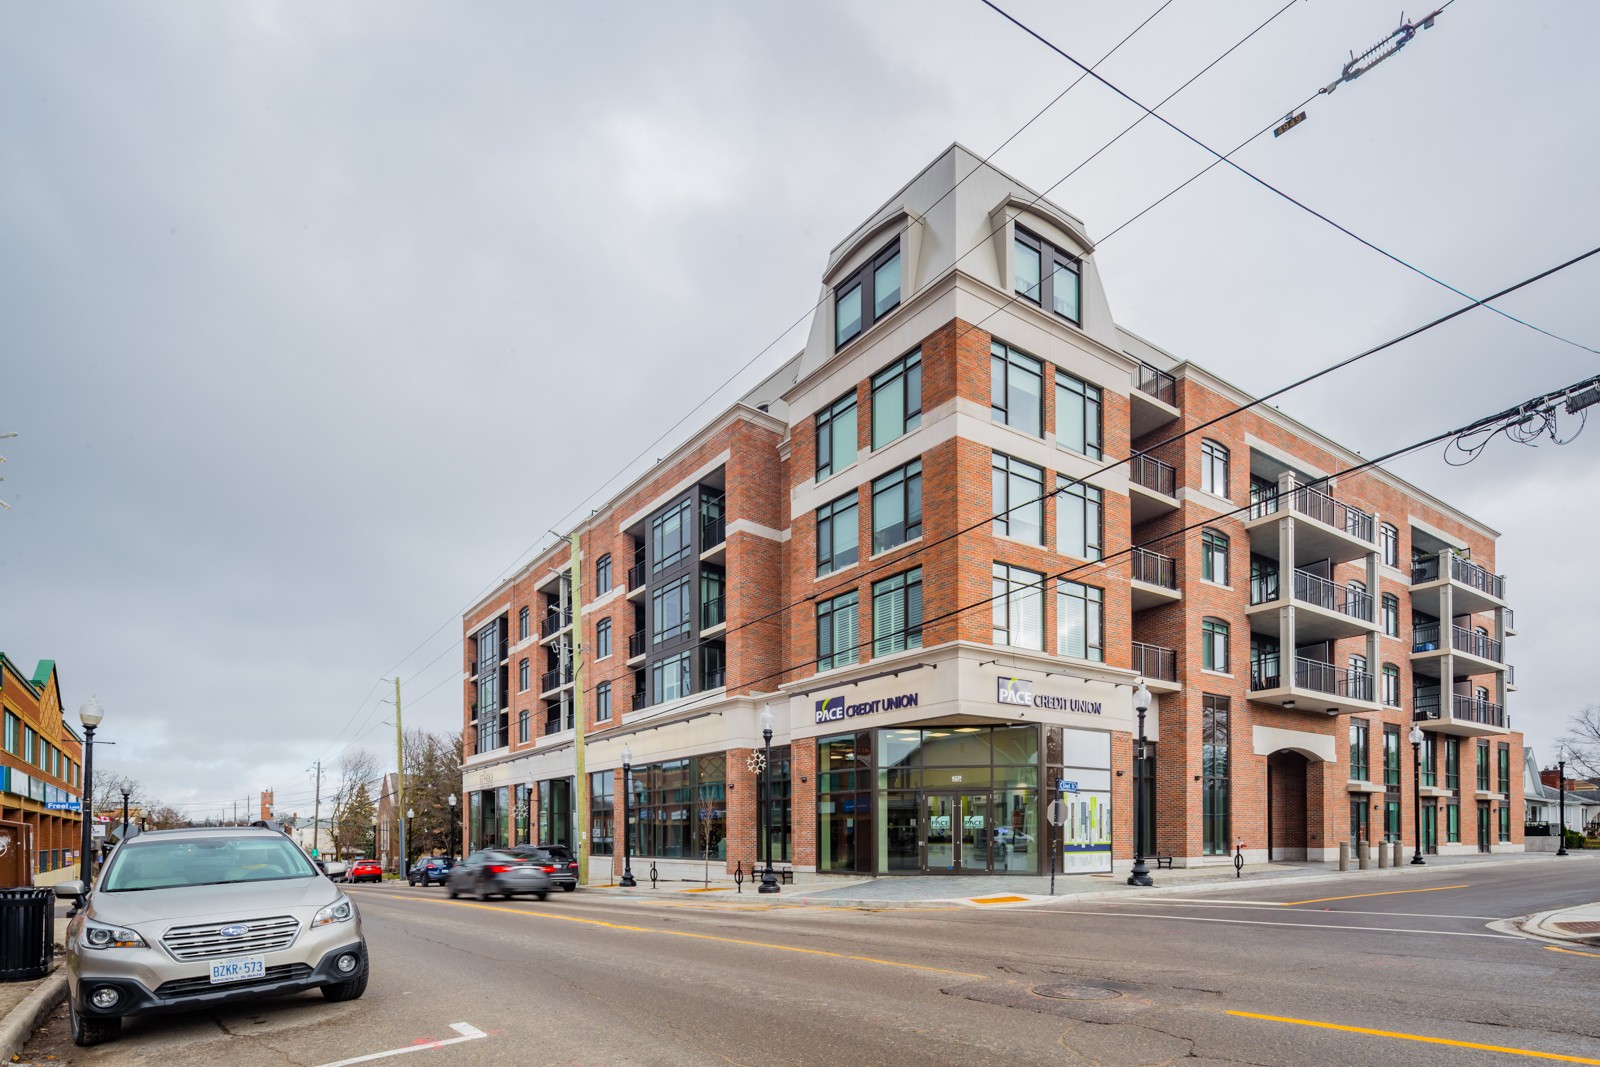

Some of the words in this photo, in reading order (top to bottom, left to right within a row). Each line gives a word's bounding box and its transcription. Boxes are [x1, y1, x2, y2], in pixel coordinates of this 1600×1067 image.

[1278, 114, 1302, 134] 4949
[815, 706, 843, 723] PACE
[845, 699, 881, 718] CREDIT
[881, 692, 918, 711] UNION
[999, 688, 1032, 705] PACE
[1033, 694, 1068, 710] CREDIT
[1070, 698, 1102, 715] UNION
[213, 963, 239, 978] BZKR
[244, 961, 263, 974] 573
